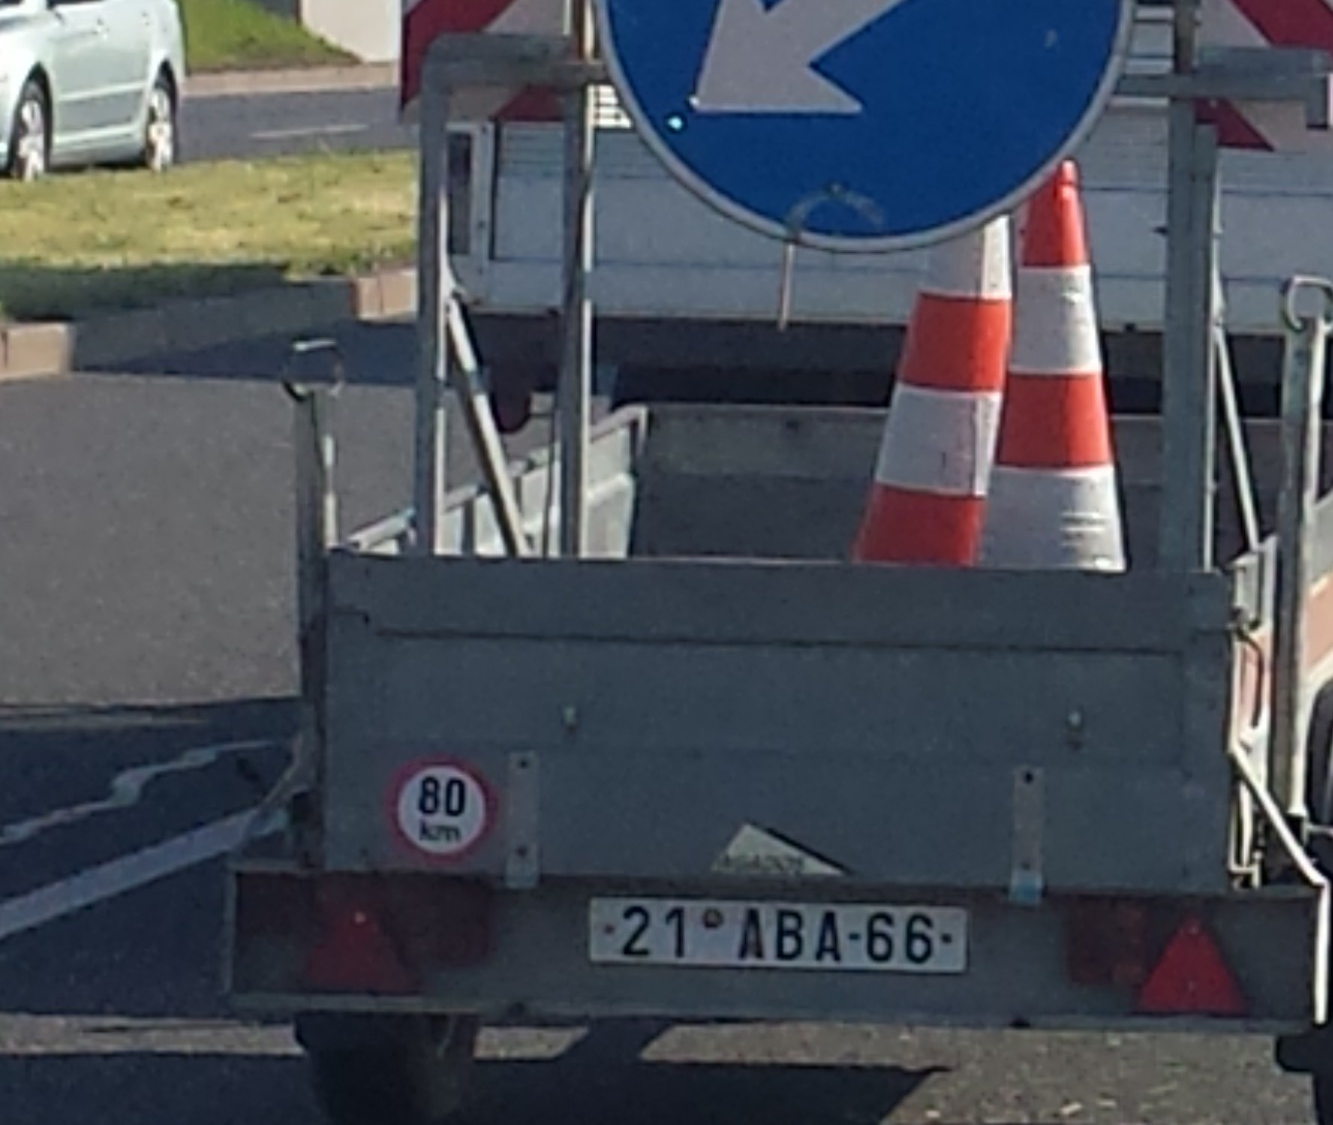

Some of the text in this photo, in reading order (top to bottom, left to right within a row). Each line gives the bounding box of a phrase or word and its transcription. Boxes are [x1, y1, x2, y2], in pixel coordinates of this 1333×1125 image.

[418, 775, 466, 817] 80
[418, 818, 461, 843] km
[738, 907, 935, 964] ABA-66
